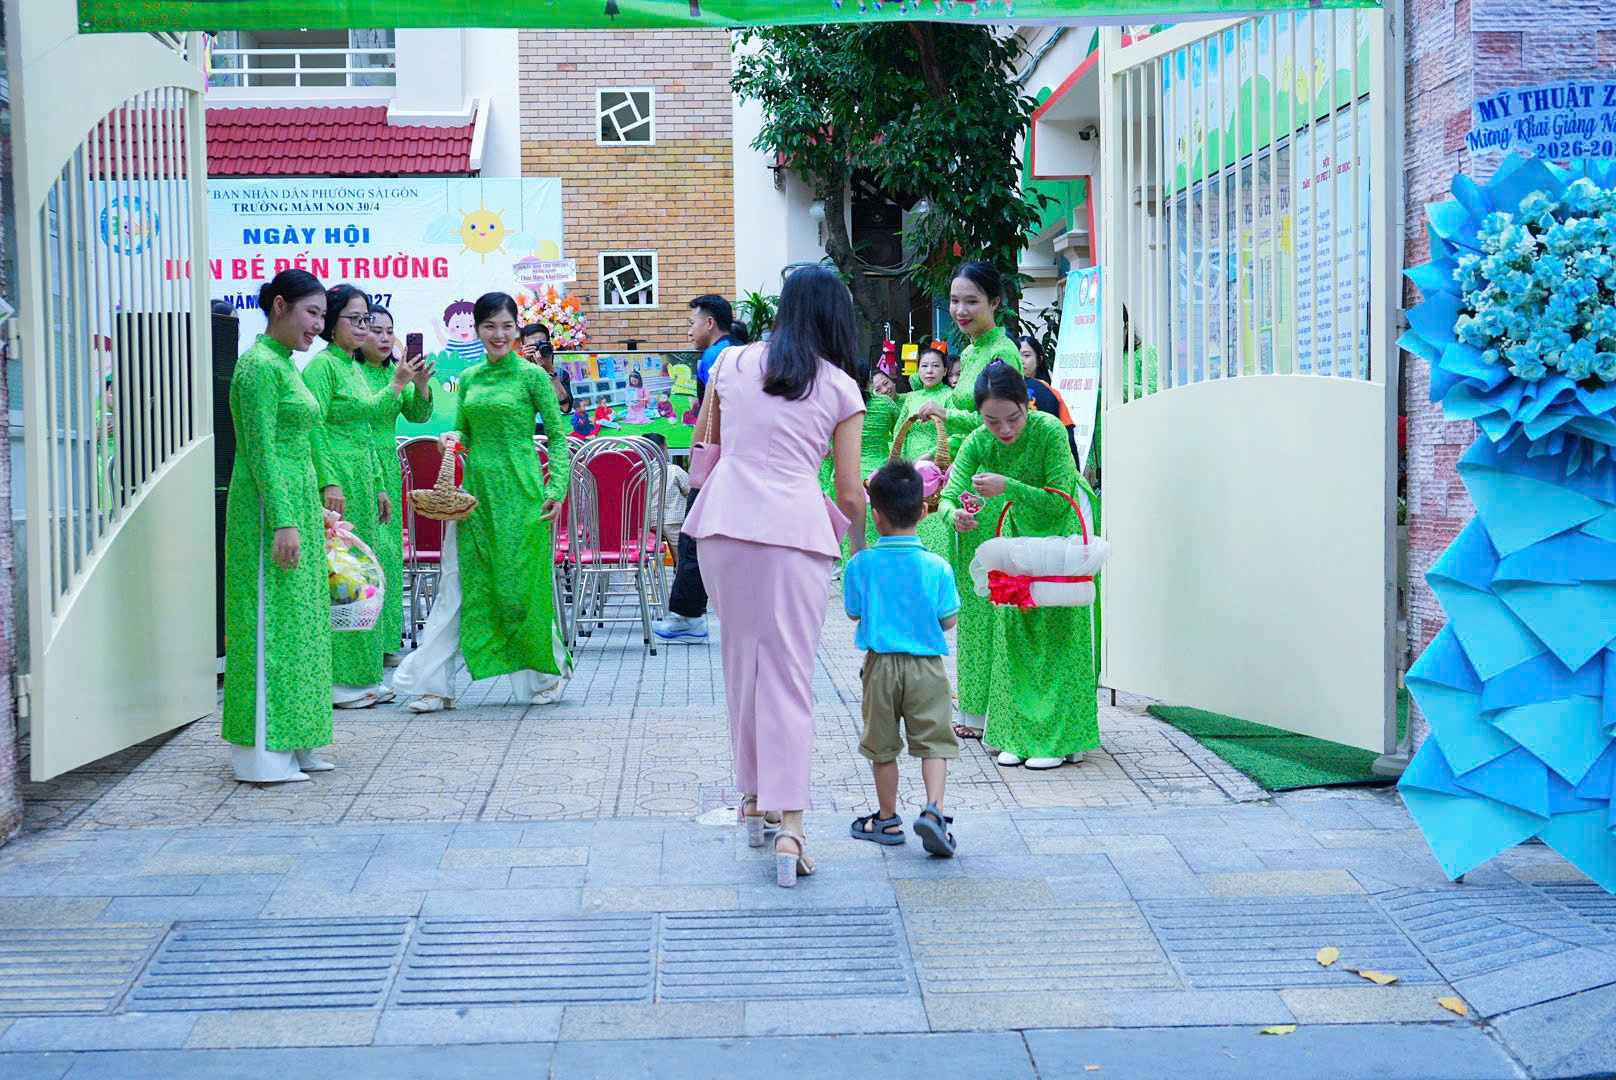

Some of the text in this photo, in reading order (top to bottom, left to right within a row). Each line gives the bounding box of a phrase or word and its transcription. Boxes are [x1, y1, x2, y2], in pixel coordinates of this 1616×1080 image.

[1478, 91, 1511, 123] MỸ
[1518, 81, 1595, 113] THUẬT
[1513, 113, 1550, 144] Khai
[1536, 139, 1616, 160] 2026-20
[213, 189, 240, 200] BAN
[242, 186, 279, 200] NHÂN
[282, 186, 309, 199] DÂN
[312, 186, 365, 199] PHƯỜNG
[368, 186, 388, 199] SÀI
[391, 185, 419, 199] GÒN
[231, 200, 288, 213] TRƯỜNG
[324, 201, 354, 213] NON
[357, 201, 380, 212] 30/4
[243, 223, 370, 247] NGÀY HỘI
[231, 253, 265, 280] BÉ
[338, 251, 449, 279] TRƯỜNG
